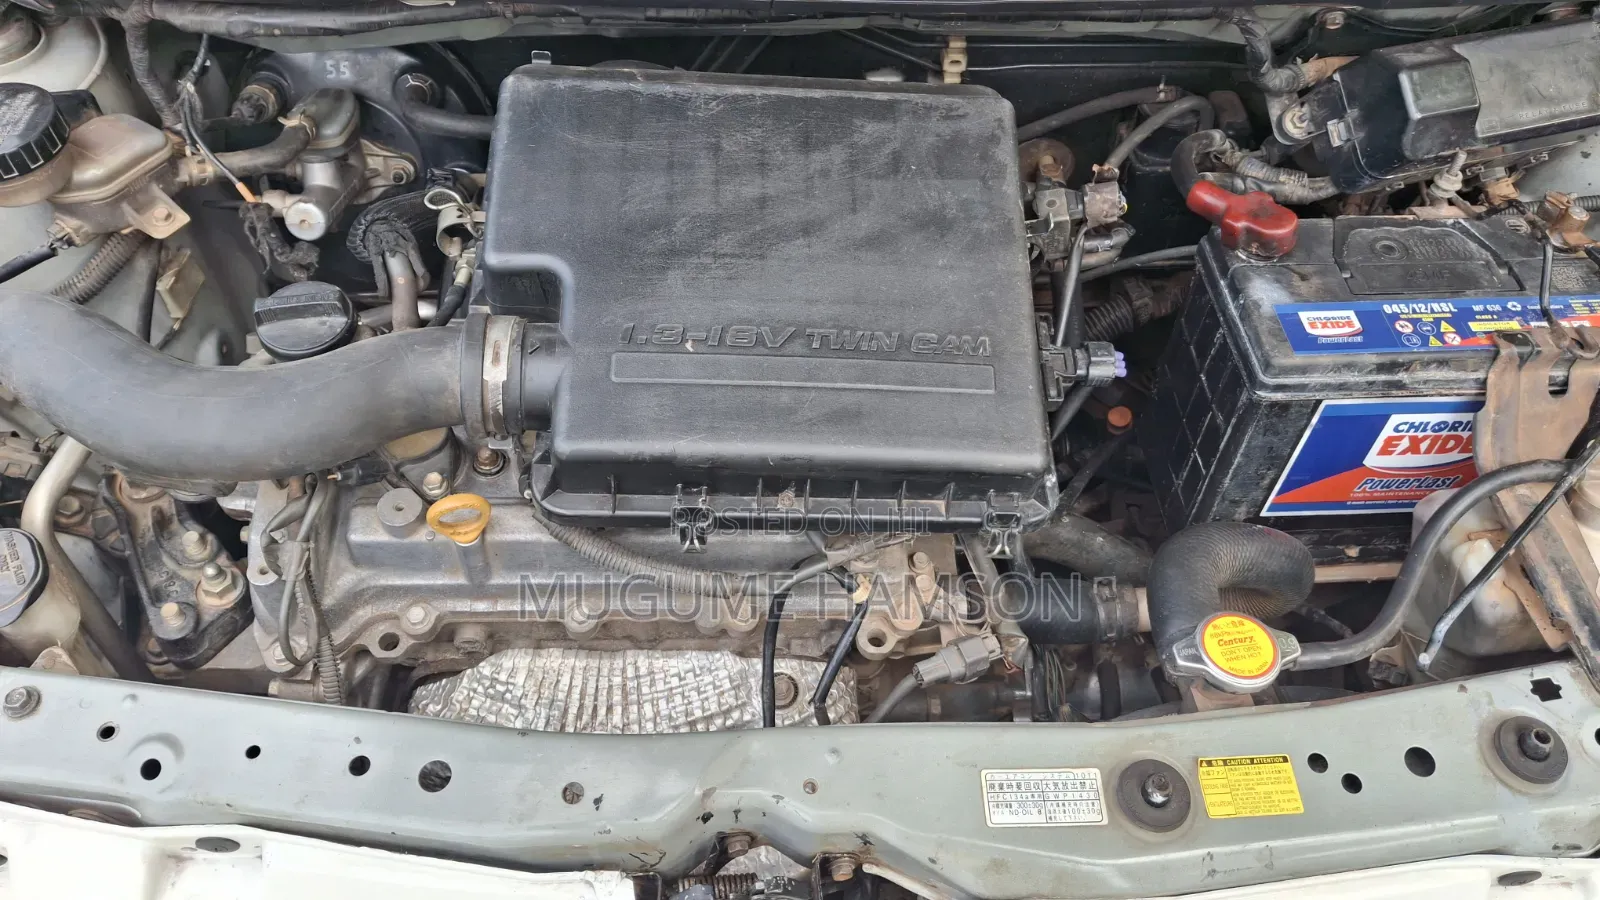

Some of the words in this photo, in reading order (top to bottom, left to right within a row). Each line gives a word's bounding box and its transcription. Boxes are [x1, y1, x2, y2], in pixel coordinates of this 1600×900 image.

[1307, 320, 1356, 330] EXIDE
[805, 328, 900, 353] TWIN
[910, 332, 991, 357] CAM
[1392, 420, 1473, 434] CHLORI
[1242, 645, 1262, 654] OPEN
[1224, 654, 1247, 663] WHEN
[1226, 758, 1251, 766] CAUTION
